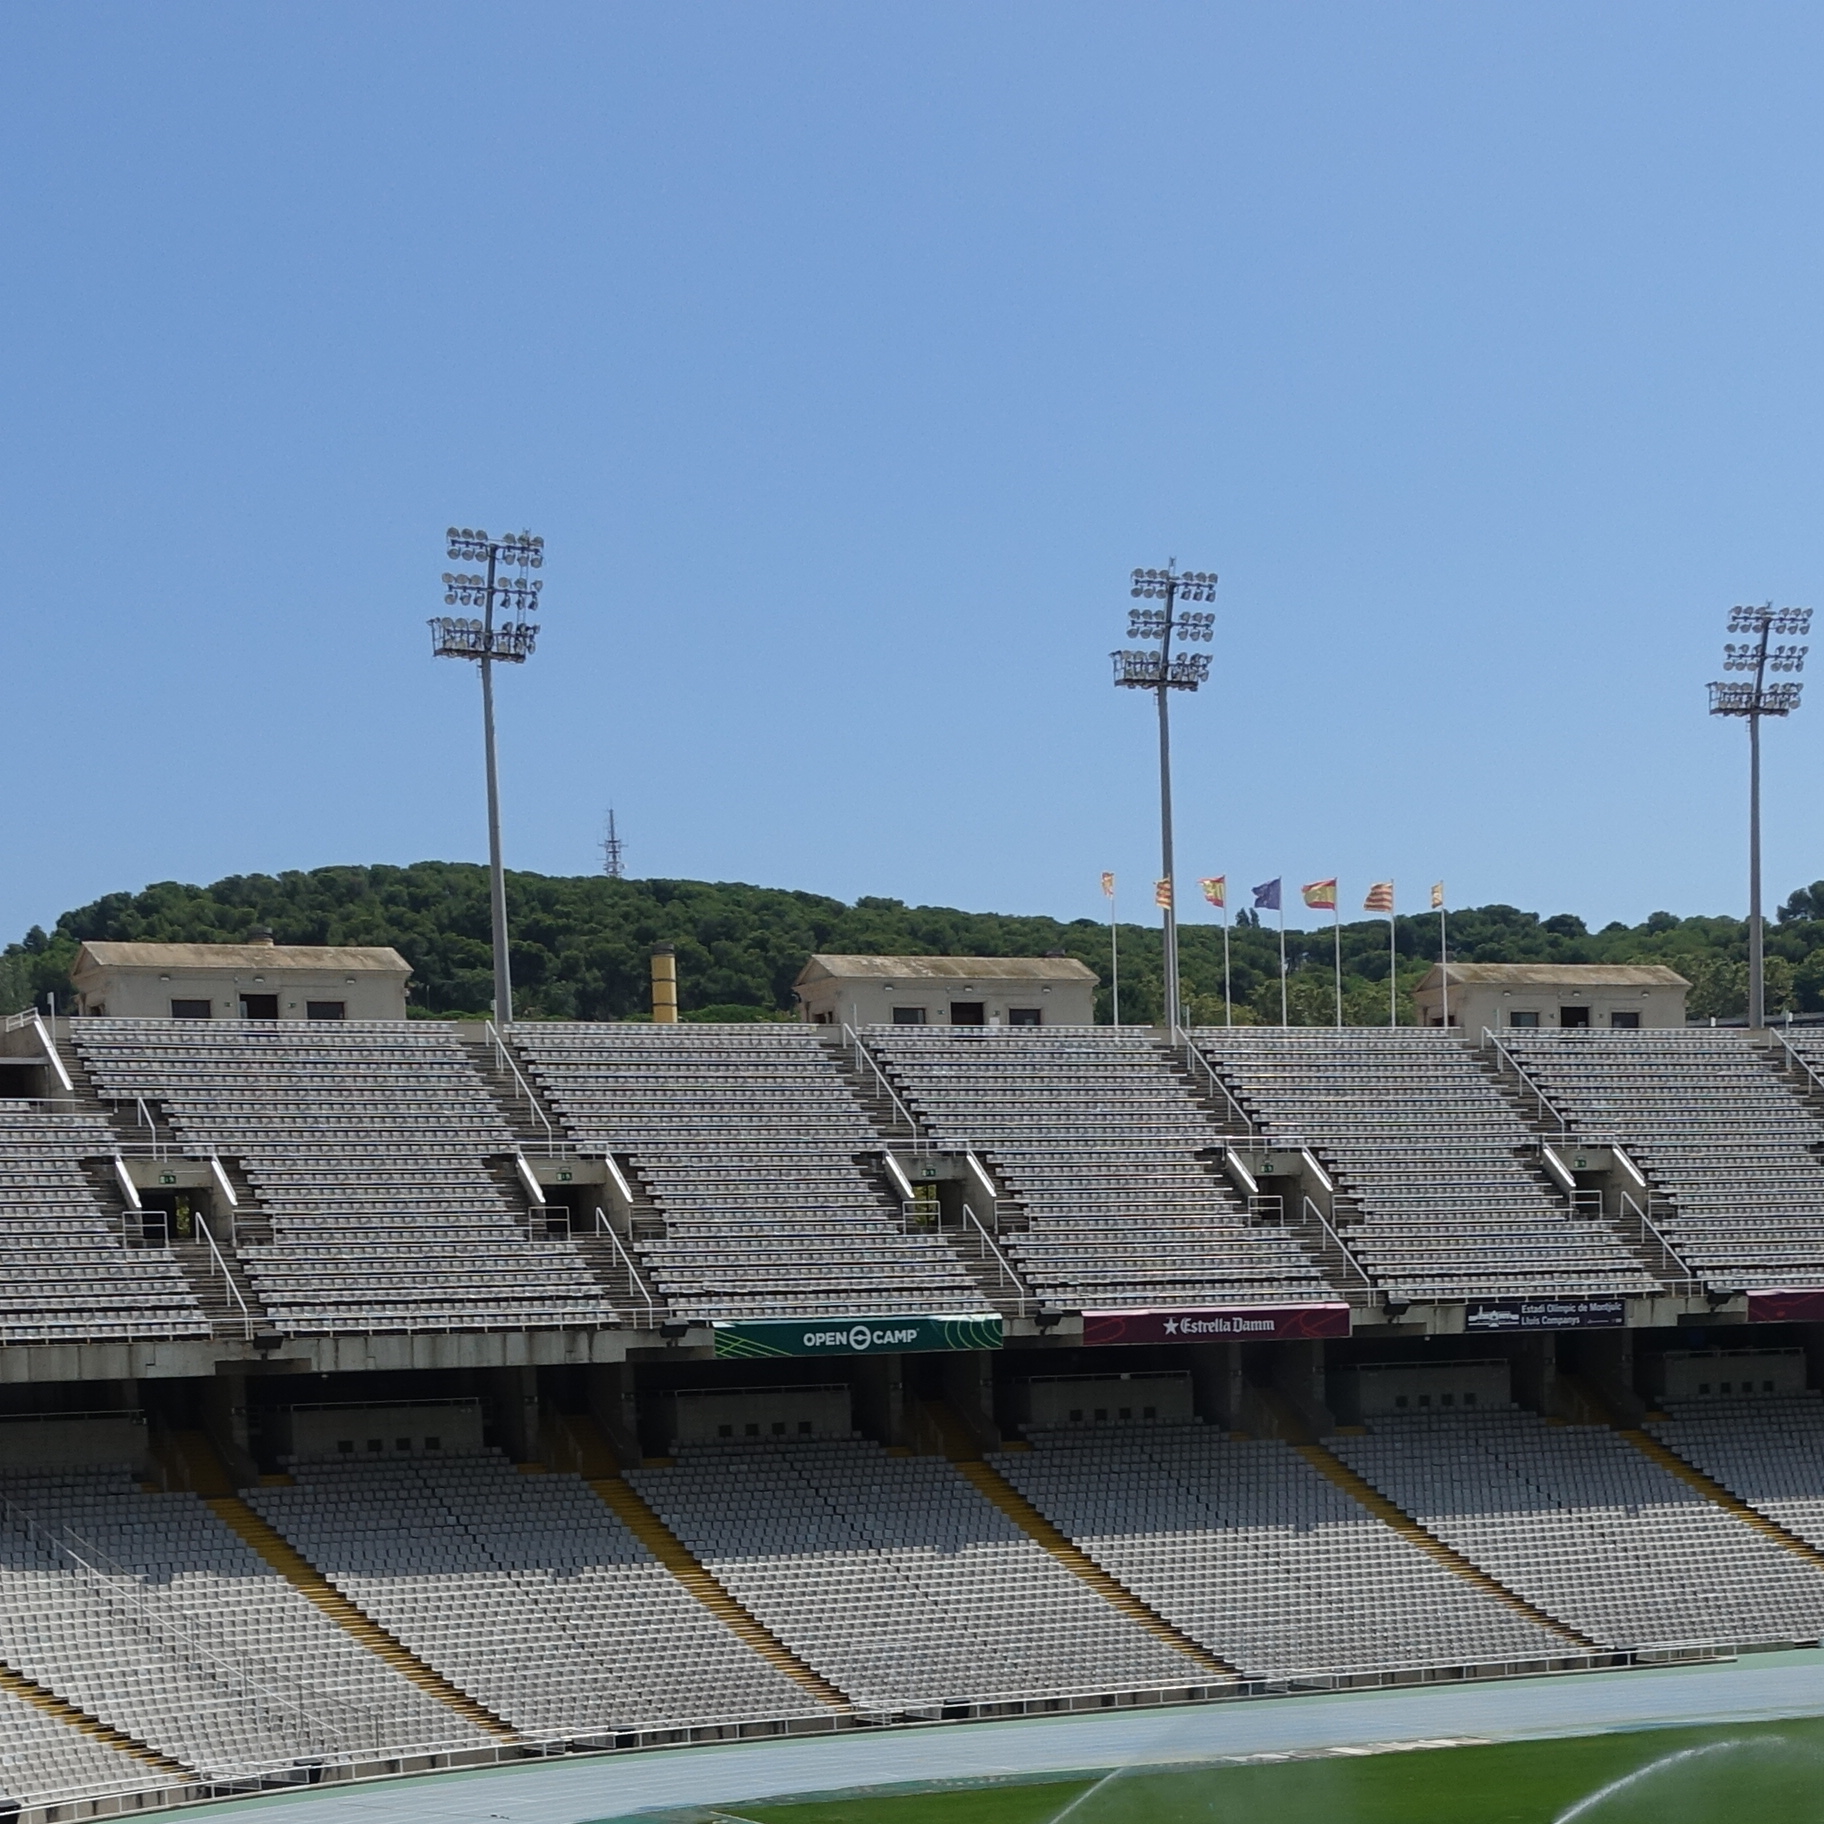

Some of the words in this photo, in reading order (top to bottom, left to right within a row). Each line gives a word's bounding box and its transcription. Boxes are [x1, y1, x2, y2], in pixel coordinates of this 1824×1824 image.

[1578, 1303, 1588, 1313] de
[1179, 1317, 1232, 1334] Estrella
[1232, 1316, 1275, 1334] Damm
[803, 1330, 848, 1347] OPEN
[872, 1328, 917, 1346] CAMP
